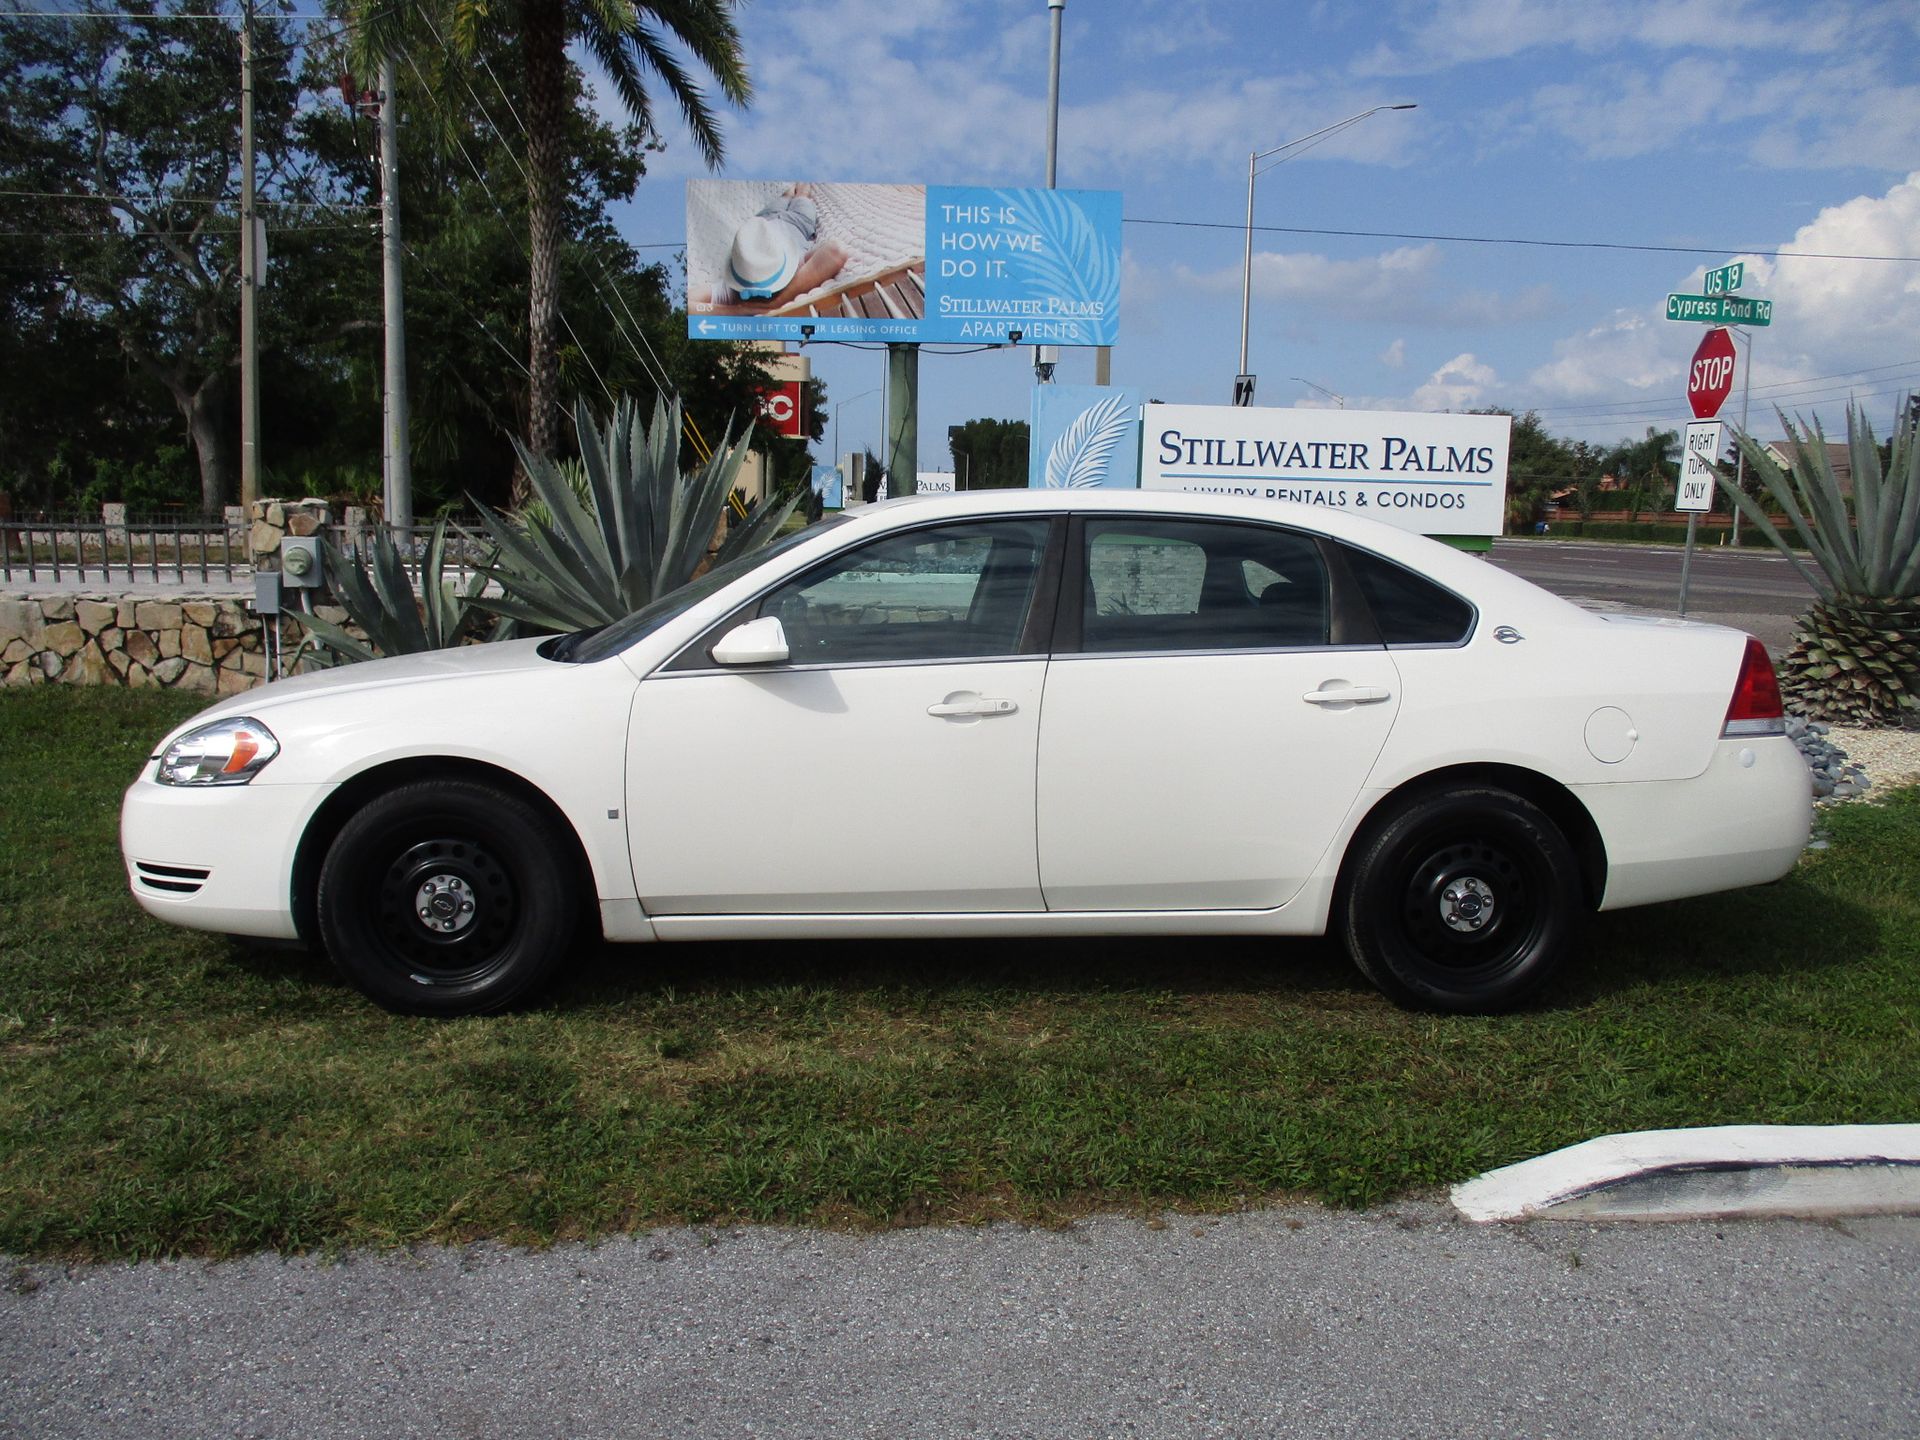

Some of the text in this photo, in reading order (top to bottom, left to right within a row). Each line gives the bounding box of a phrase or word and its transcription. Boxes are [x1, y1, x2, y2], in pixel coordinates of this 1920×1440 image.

[941, 205, 1016, 224] THIS IS
[941, 232, 1042, 252] HOW WE
[941, 259, 1008, 278] DO IT.
[1706, 265, 1739, 294] US 19
[939, 295, 1104, 316] STILLWATER PALMS
[1668, 296, 1771, 320] Cypress Pond Rd
[721, 322, 751, 333] TURN
[756, 323, 780, 333] LEFT
[784, 324, 799, 333] TO
[831, 325, 876, 335] LEASING
[880, 326, 918, 335] OFFICE
[960, 320, 1079, 339] APARTMENTS
[1691, 356, 1733, 392] STOP
[1689, 433, 1715, 450] RIGHT
[1159, 430, 1493, 473] STILLWATER PALMS
[1355, 491, 1368, 507] &
[1377, 491, 1465, 509] CONDOS
[1684, 482, 1705, 499] ONLY
